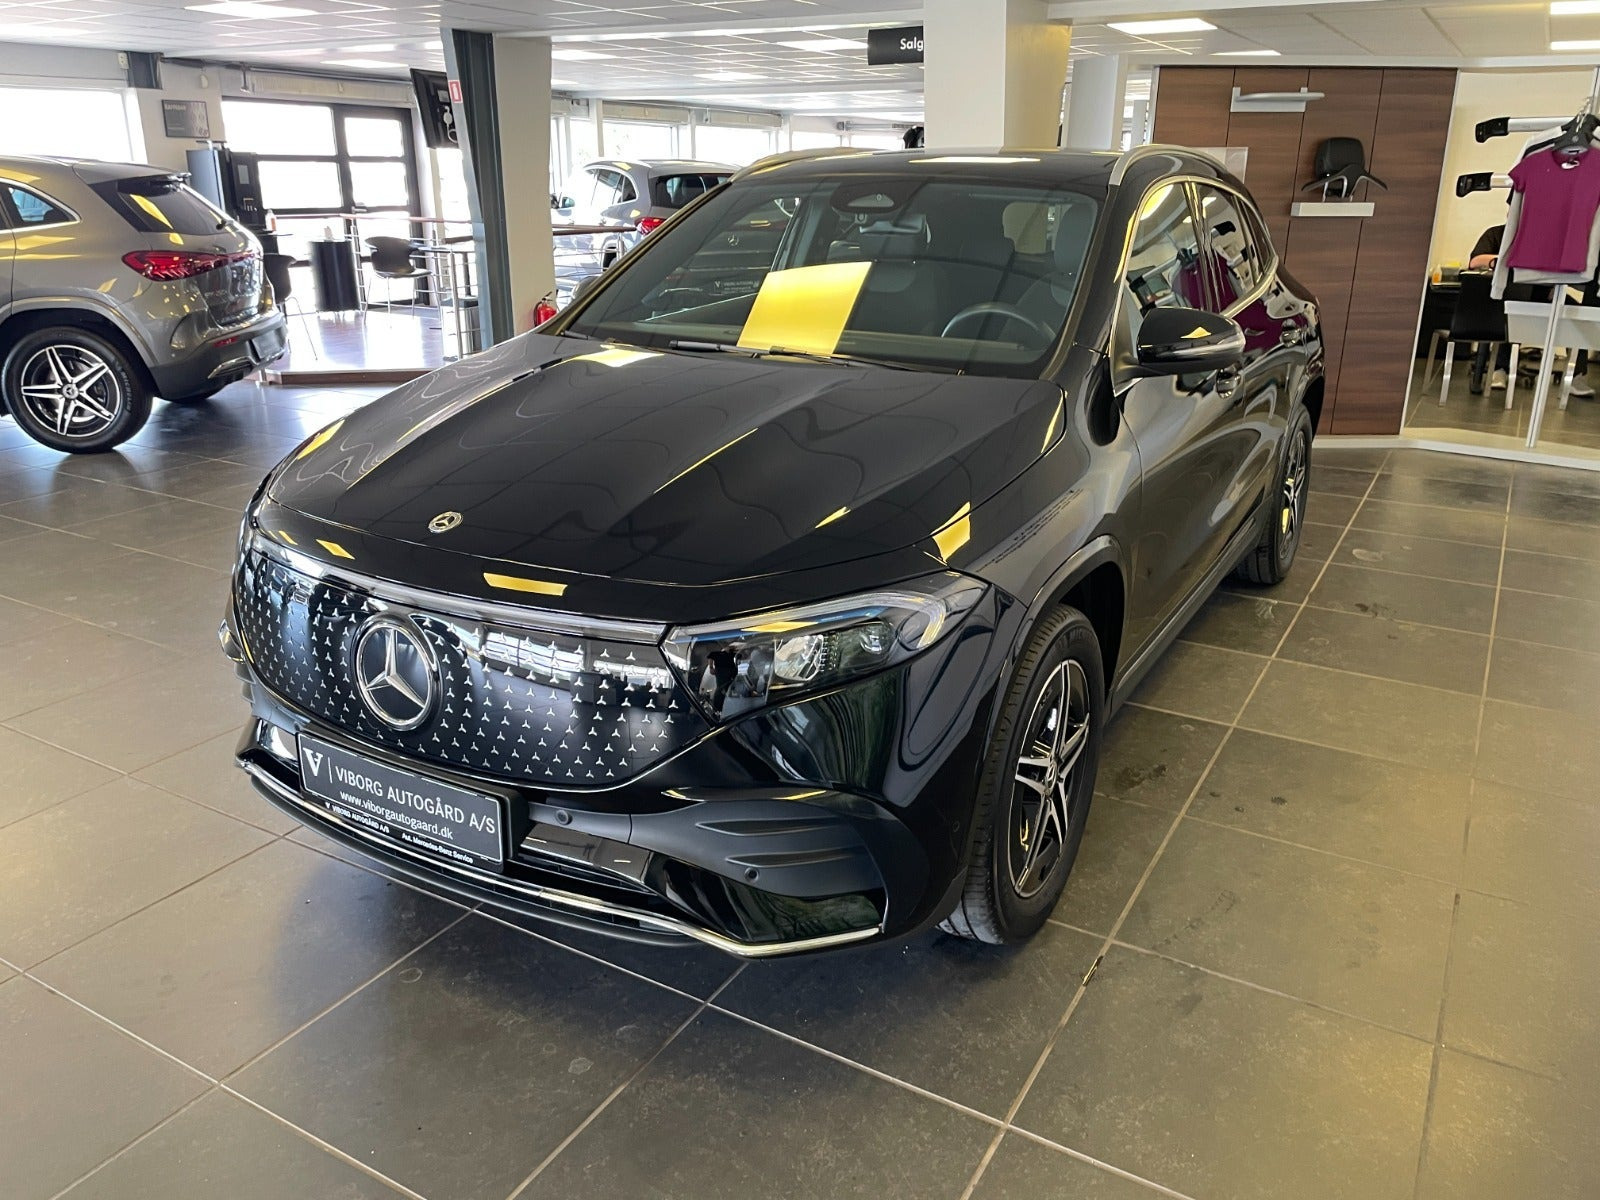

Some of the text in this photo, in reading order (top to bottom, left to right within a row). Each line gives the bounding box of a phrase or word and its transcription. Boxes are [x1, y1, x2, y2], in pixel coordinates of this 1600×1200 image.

[900, 36, 924, 52] Salg
[332, 805, 351, 818] VIBORG
[335, 765, 496, 834] VIBORG AUTOGÅRD A/S
[340, 790, 454, 840] www.viborgautogaard.dk
[413, 836, 453, 857] Mercedes-Benz
[453, 850, 474, 864] Service
